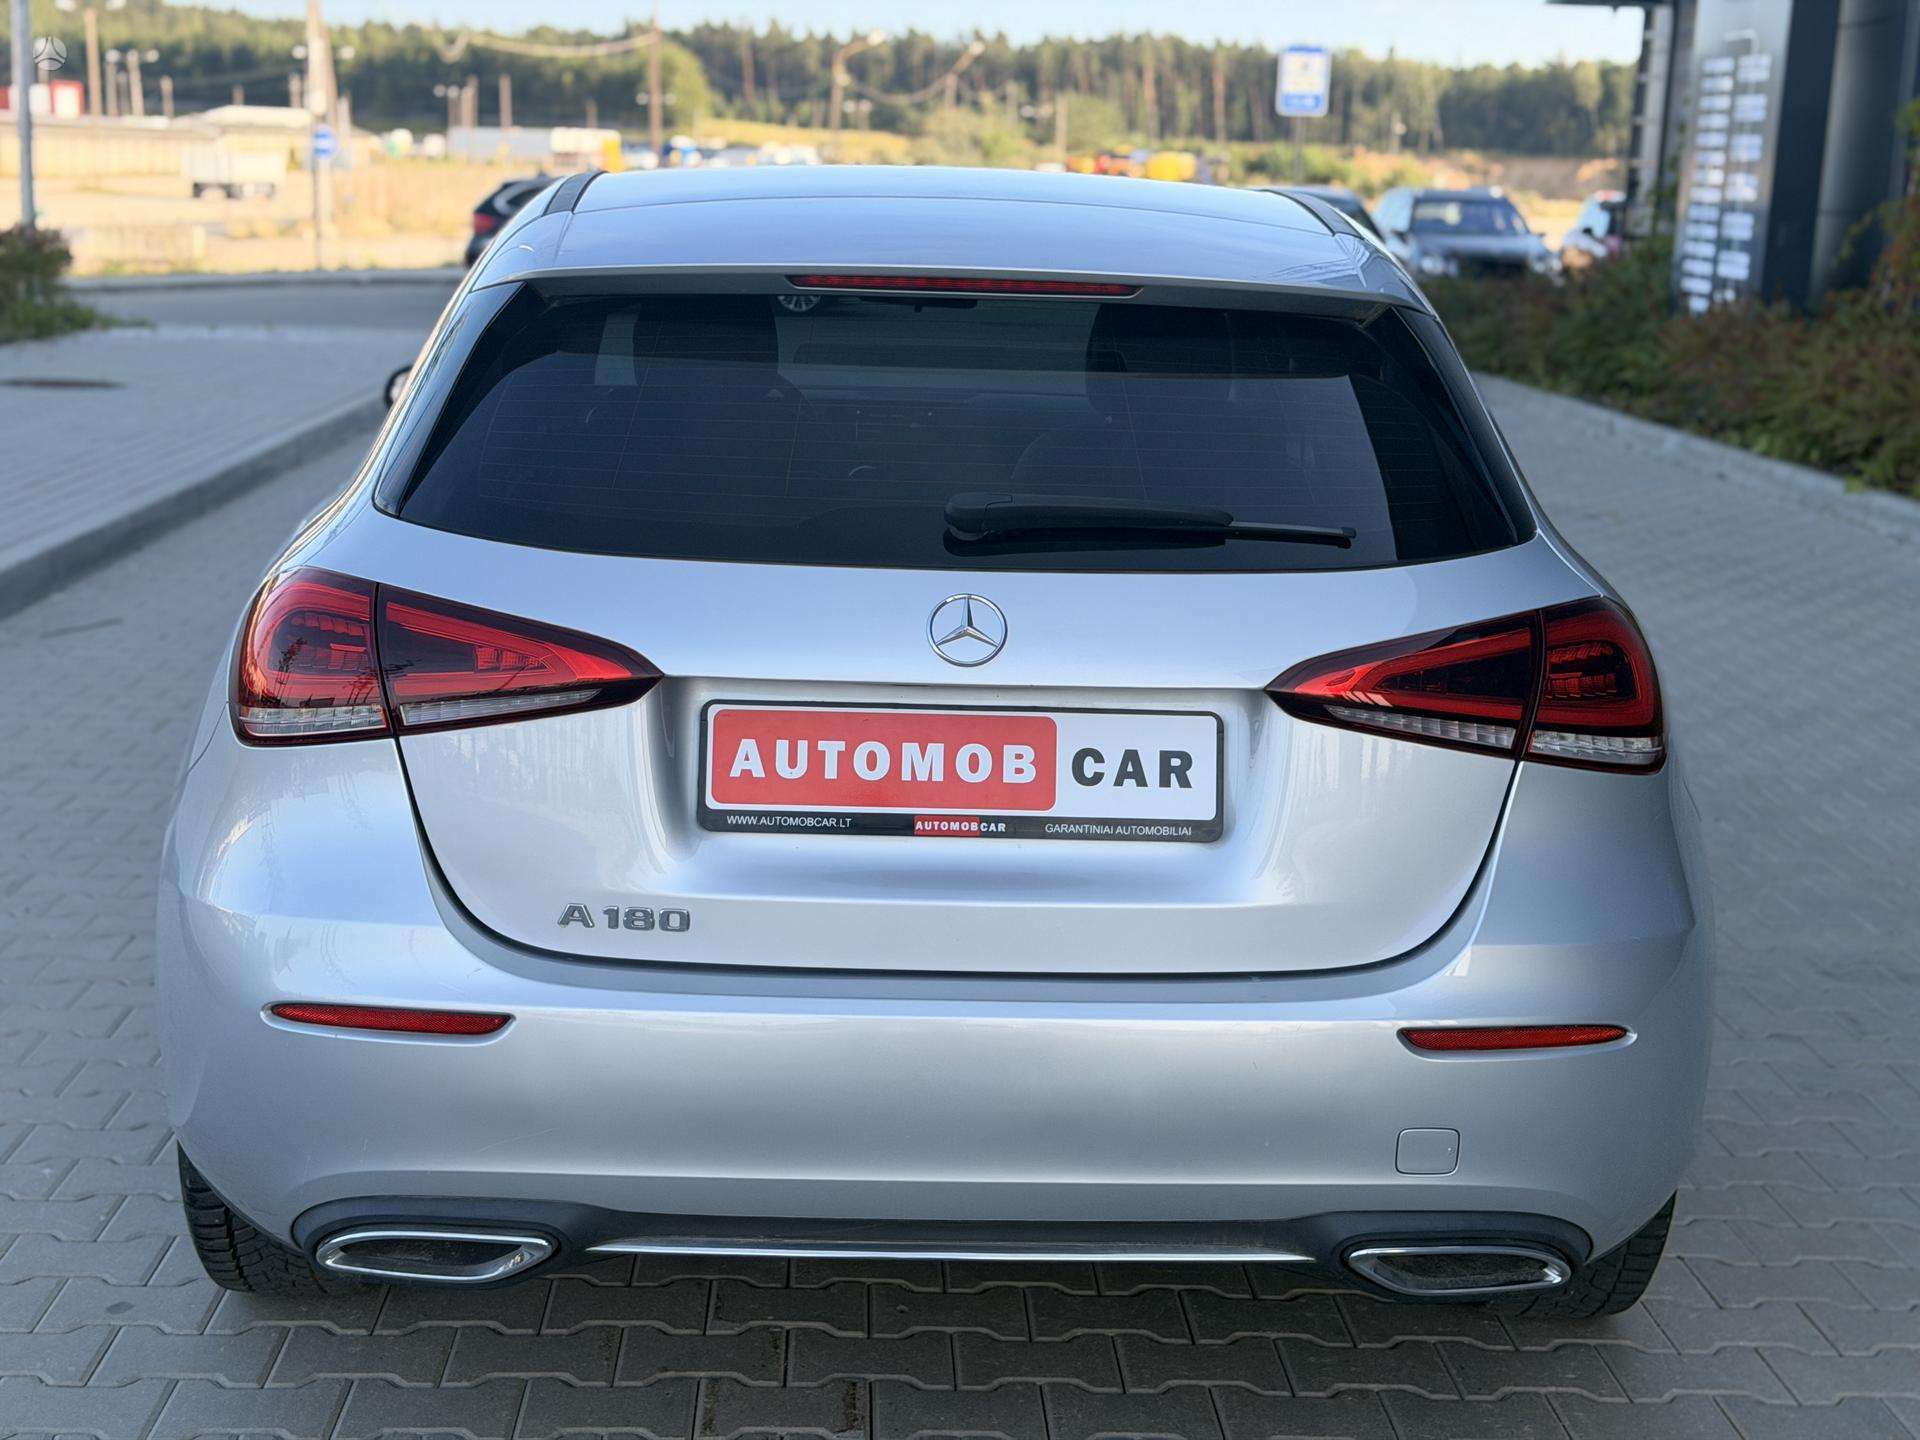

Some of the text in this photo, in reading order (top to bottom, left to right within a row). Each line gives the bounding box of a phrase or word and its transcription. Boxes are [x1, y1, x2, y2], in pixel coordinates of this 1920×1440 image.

[730, 738, 1193, 789] AUTOMOB CAR
[727, 815, 852, 828] WWW.AUTOMOBCAR.LT
[1045, 823, 1192, 836] GARANTINIAI AUTOMOBILIAI
[557, 902, 691, 932] A 180
